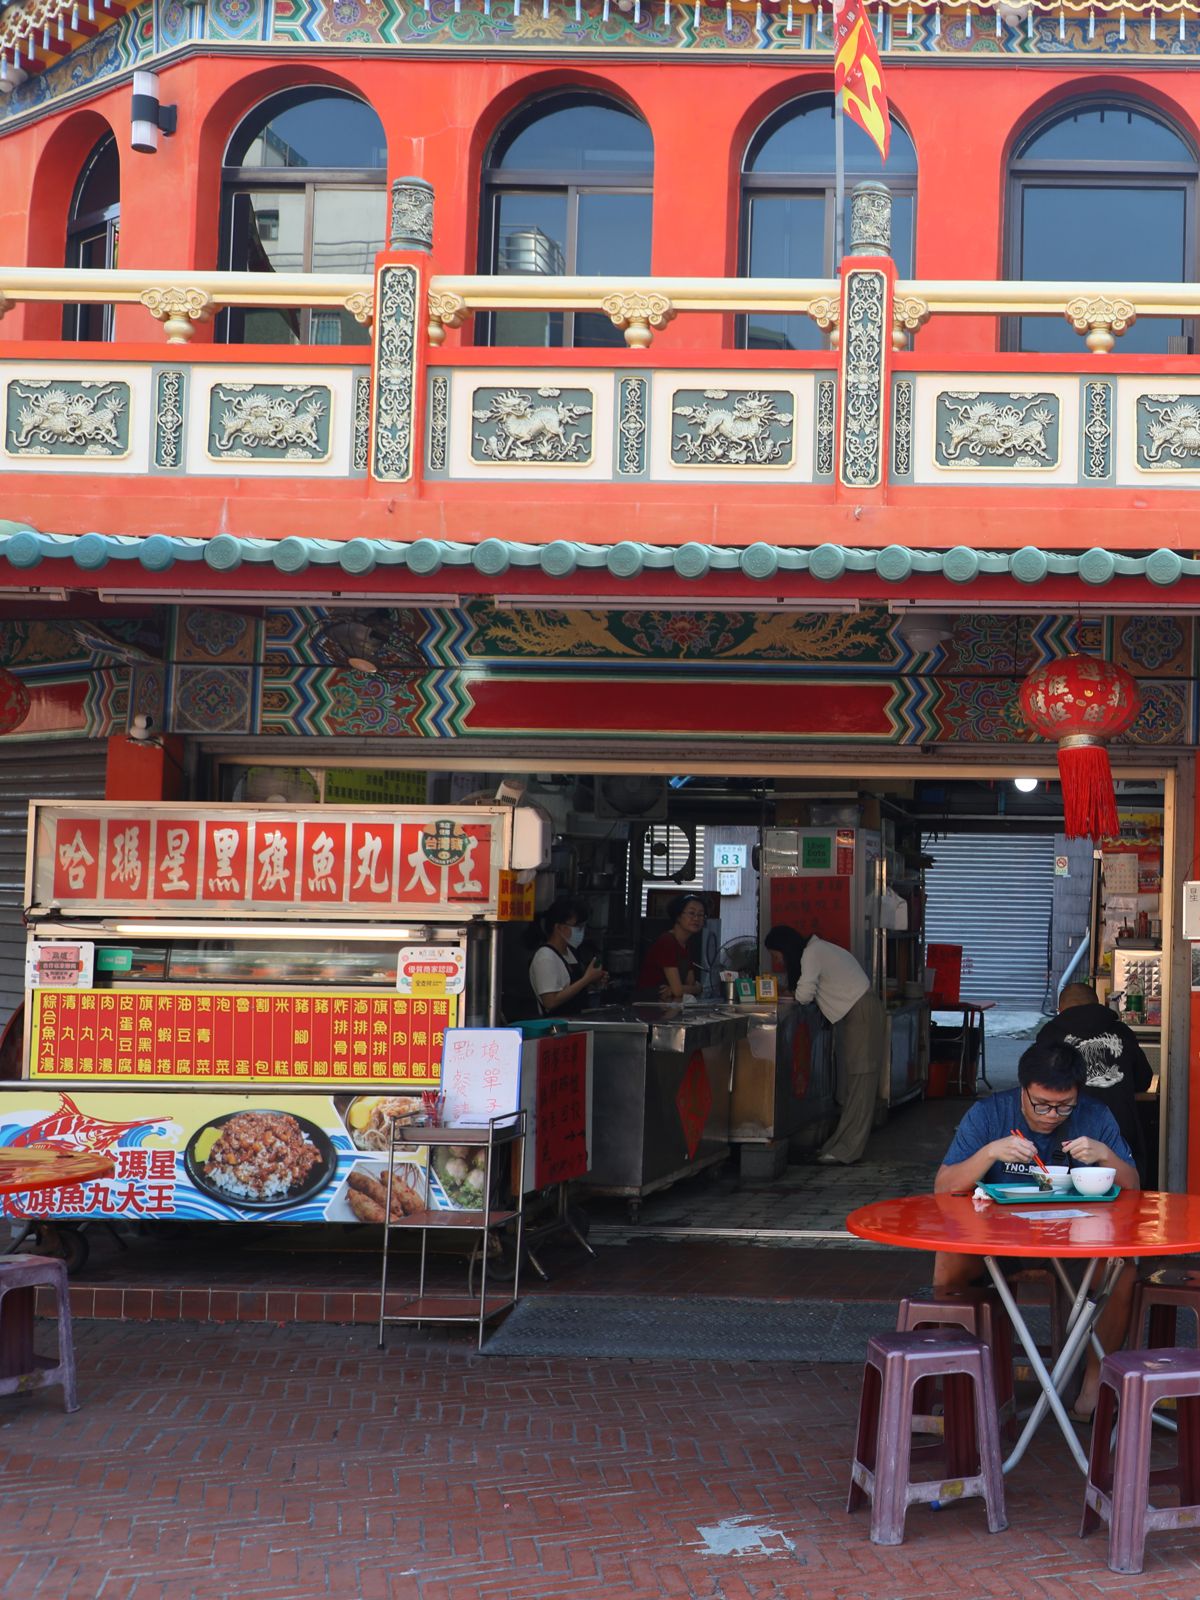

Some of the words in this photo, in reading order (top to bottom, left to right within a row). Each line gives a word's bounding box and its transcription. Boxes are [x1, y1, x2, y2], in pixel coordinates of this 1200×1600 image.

[58, 826, 483, 896] 哈瑪星黑旗魚丸大王
[721, 854, 740, 865] 83
[39, 995, 58, 1073] 綜合魚丸湯
[59, 995, 76, 1073] 清丸湯
[78, 995, 96, 1073] 蝦丸湯
[98, 996, 114, 1073] 肉丸湯
[117, 996, 134, 1073] 皮蛋豆腐
[137, 996, 153, 1074] 旗魚黑輪
[157, 996, 173, 1074] 炸蝦捲
[176, 997, 192, 1074] 油豆腐
[196, 997, 212, 1074] 燙青菜
[215, 997, 231, 1075] 泡菜
[235, 998, 251, 1075] 魯蛋
[254, 998, 270, 1075] 割包
[274, 998, 290, 1075] 米糕
[294, 998, 310, 1076] 豬腳飯
[313, 999, 329, 1076] 豬腳
[333, 999, 349, 1076] 炸排骨飯
[352, 999, 368, 1076] 滷排骨飯
[372, 1000, 388, 1076] 旗魚排飯
[392, 1000, 408, 1077] 魯肉飯
[411, 1000, 428, 1077] 肉燥飯
[431, 1000, 448, 1077] 雞肉飯
[25, 1183, 176, 1214] 旗魚丸大王
